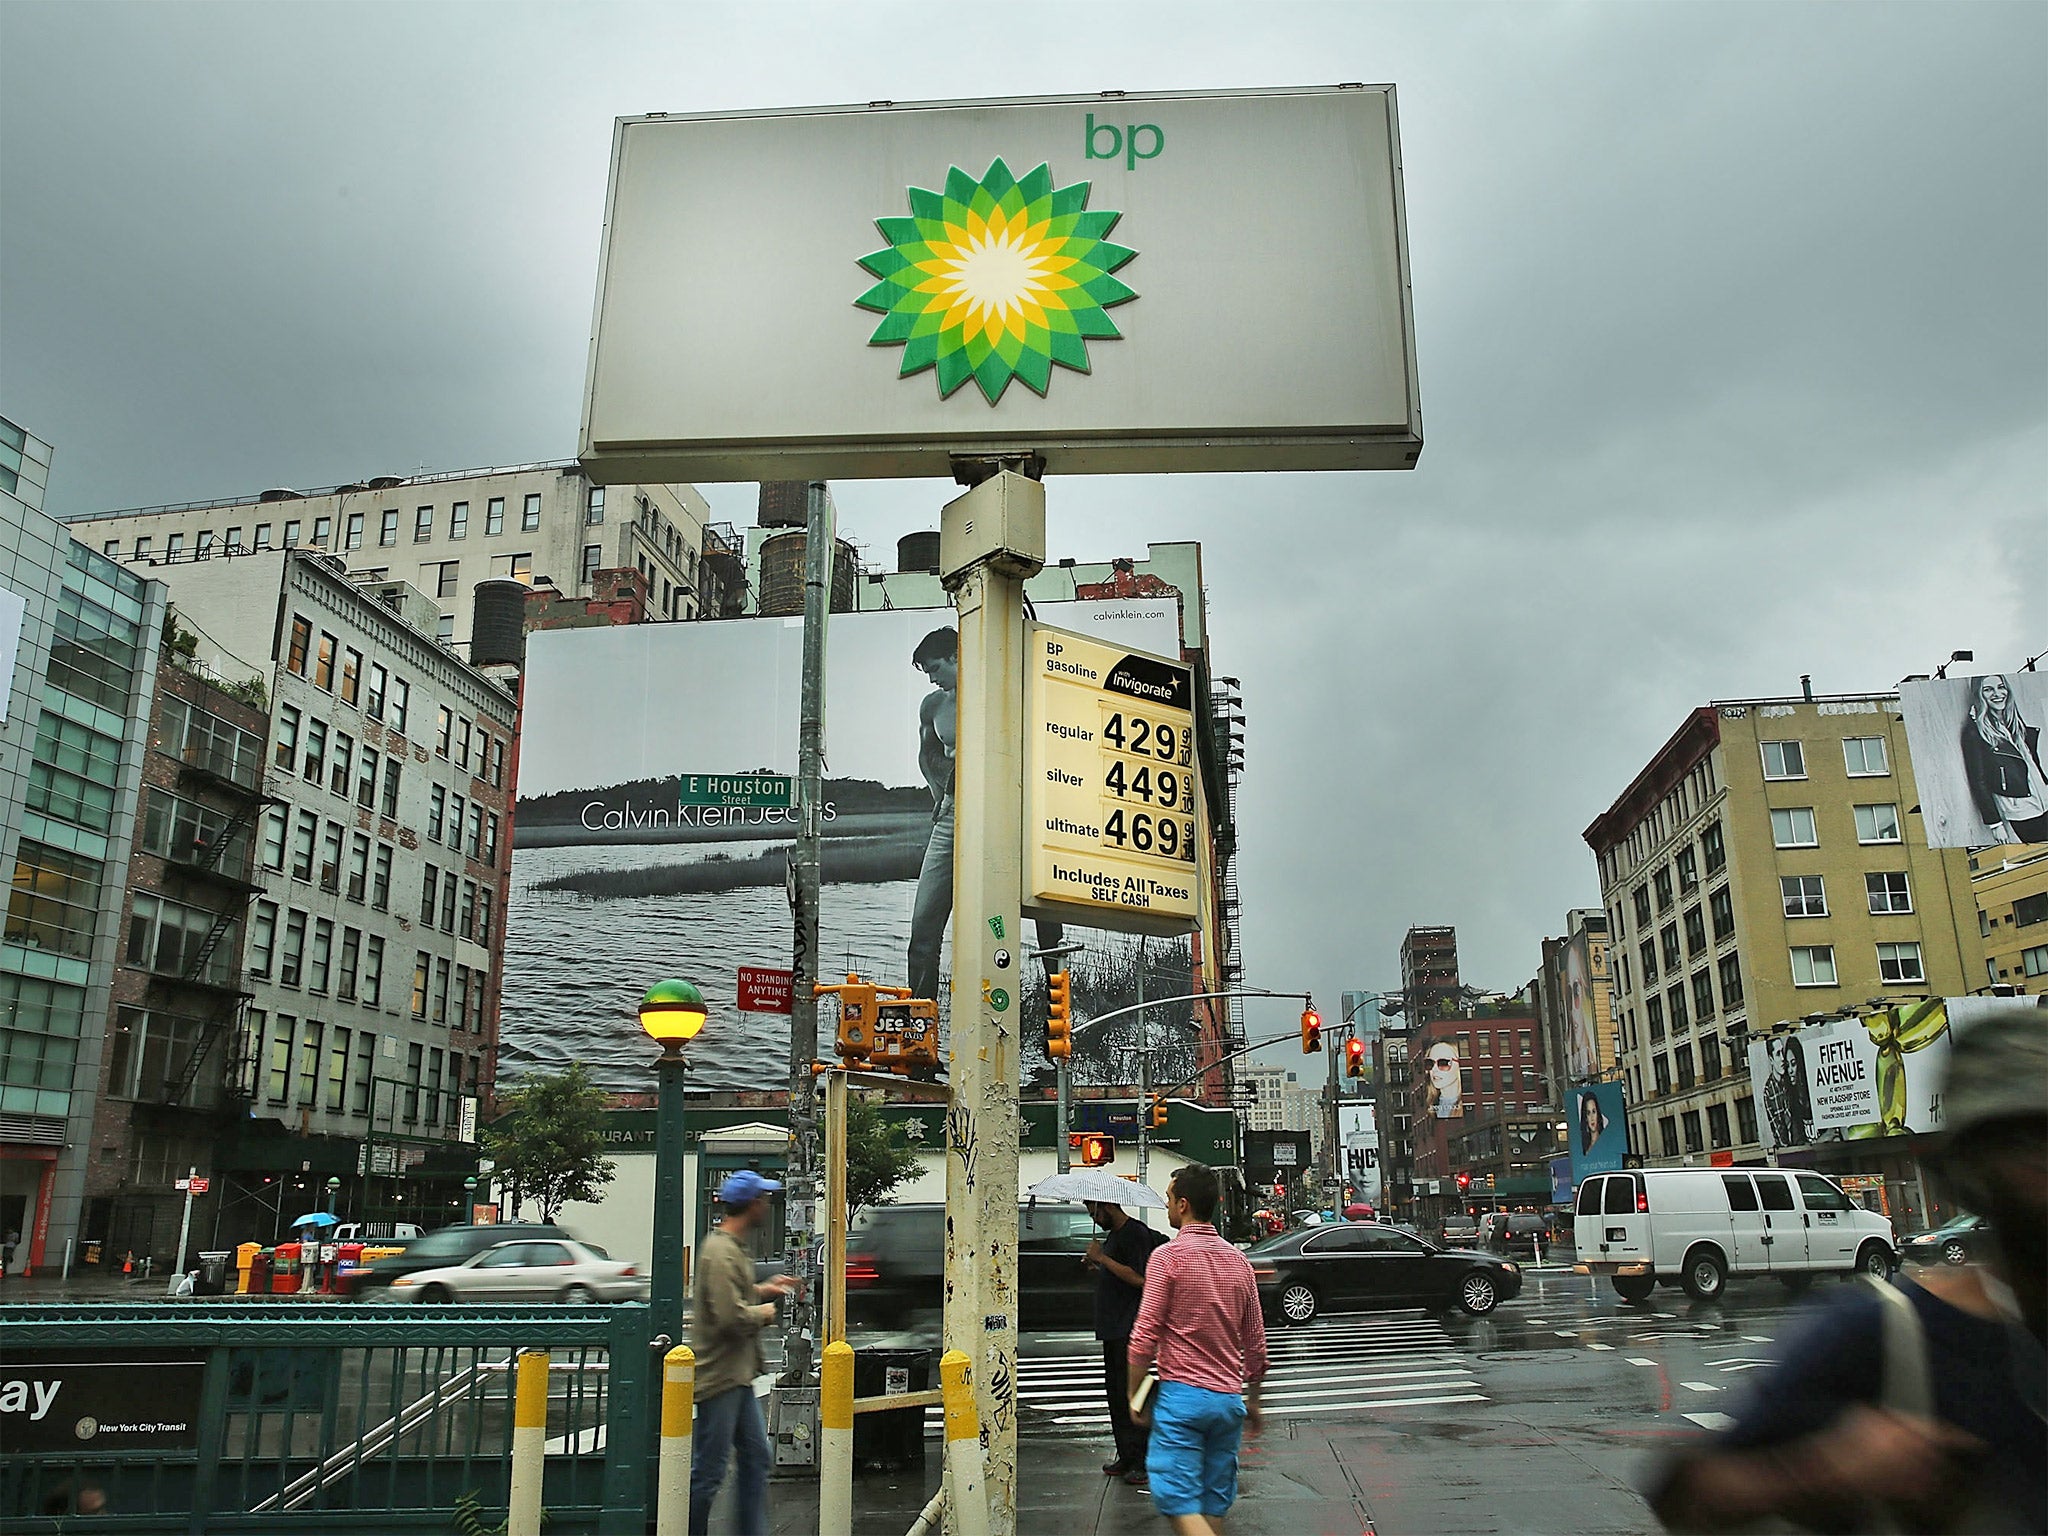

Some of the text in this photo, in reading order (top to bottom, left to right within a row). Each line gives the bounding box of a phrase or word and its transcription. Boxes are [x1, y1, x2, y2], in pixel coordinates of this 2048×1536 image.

[1085, 113, 1165, 171] bp
[1093, 609, 1164, 621] calvinklein.com
[1046, 641, 1063, 656] BP
[1046, 659, 1097, 680] gasoline
[1113, 672, 1172, 699] Invigorate
[1046, 721, 1094, 741] regular
[1103, 712, 1176, 760] 429
[689, 777, 785, 795] E Houston
[1046, 768, 1084, 787] silver
[1105, 760, 1178, 808] 449
[721, 794, 751, 805] Street
[581, 799, 669, 831] Calvin
[677, 799, 745, 828] Klein
[1046, 817, 1100, 838] ultimate
[1104, 808, 1178, 856] 469
[1053, 864, 1189, 900] Includes All Taxes
[1091, 886, 1150, 908] SELF CASH
[740, 972, 752, 982] NO
[747, 985, 788, 998] ANYTIME
[1819, 1039, 1855, 1064] FIFTH
[1816, 1060, 1866, 1087] AVENUE
[1816, 1090, 1871, 1106] NEW FLAGSHIP STORE
[1213, 1139, 1232, 1149] 318
[99, 1422, 187, 1434] New York City Transit
